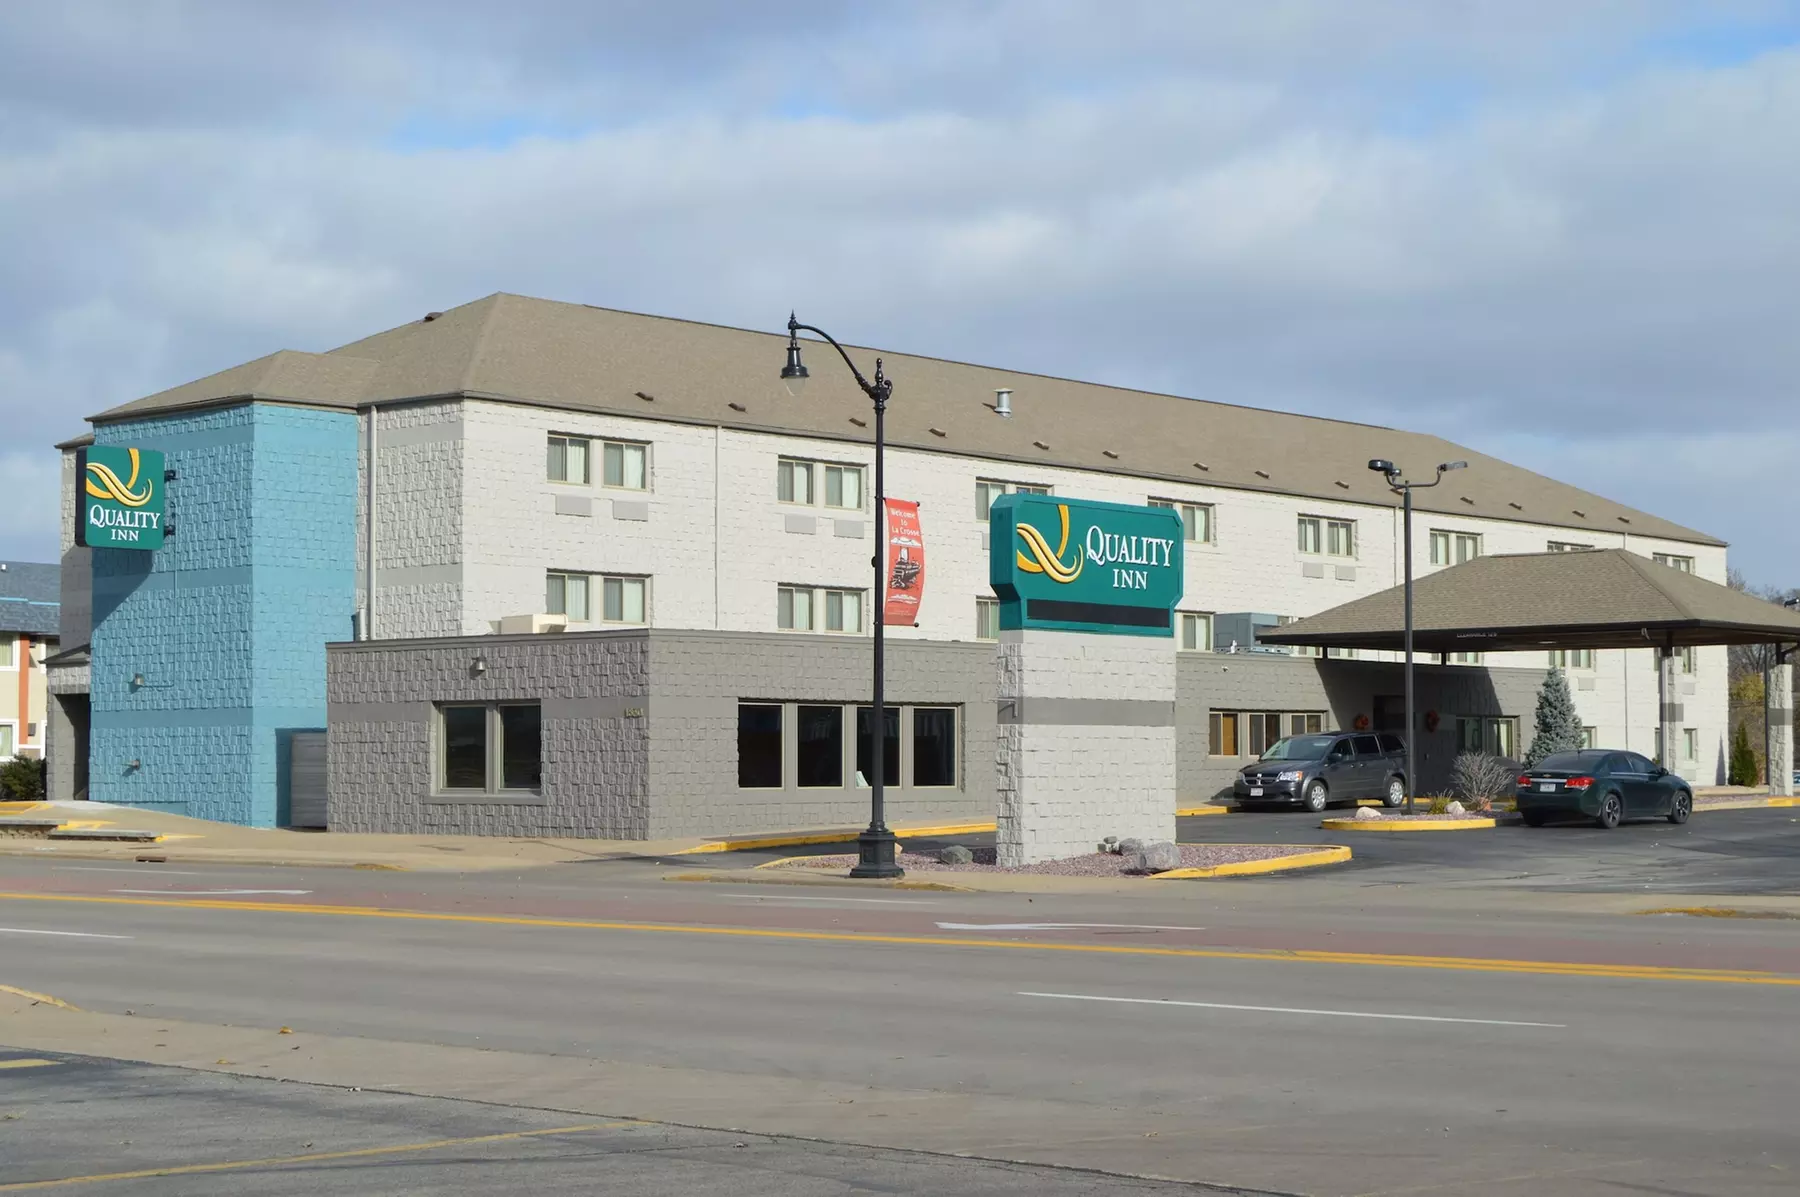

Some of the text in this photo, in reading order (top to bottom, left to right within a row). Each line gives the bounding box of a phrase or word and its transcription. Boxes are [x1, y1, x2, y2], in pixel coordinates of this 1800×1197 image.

[90, 504, 160, 529] QUALITY
[111, 529, 139, 541] INN
[1086, 525, 1174, 567] QUALITY
[1112, 568, 1148, 590] INN
